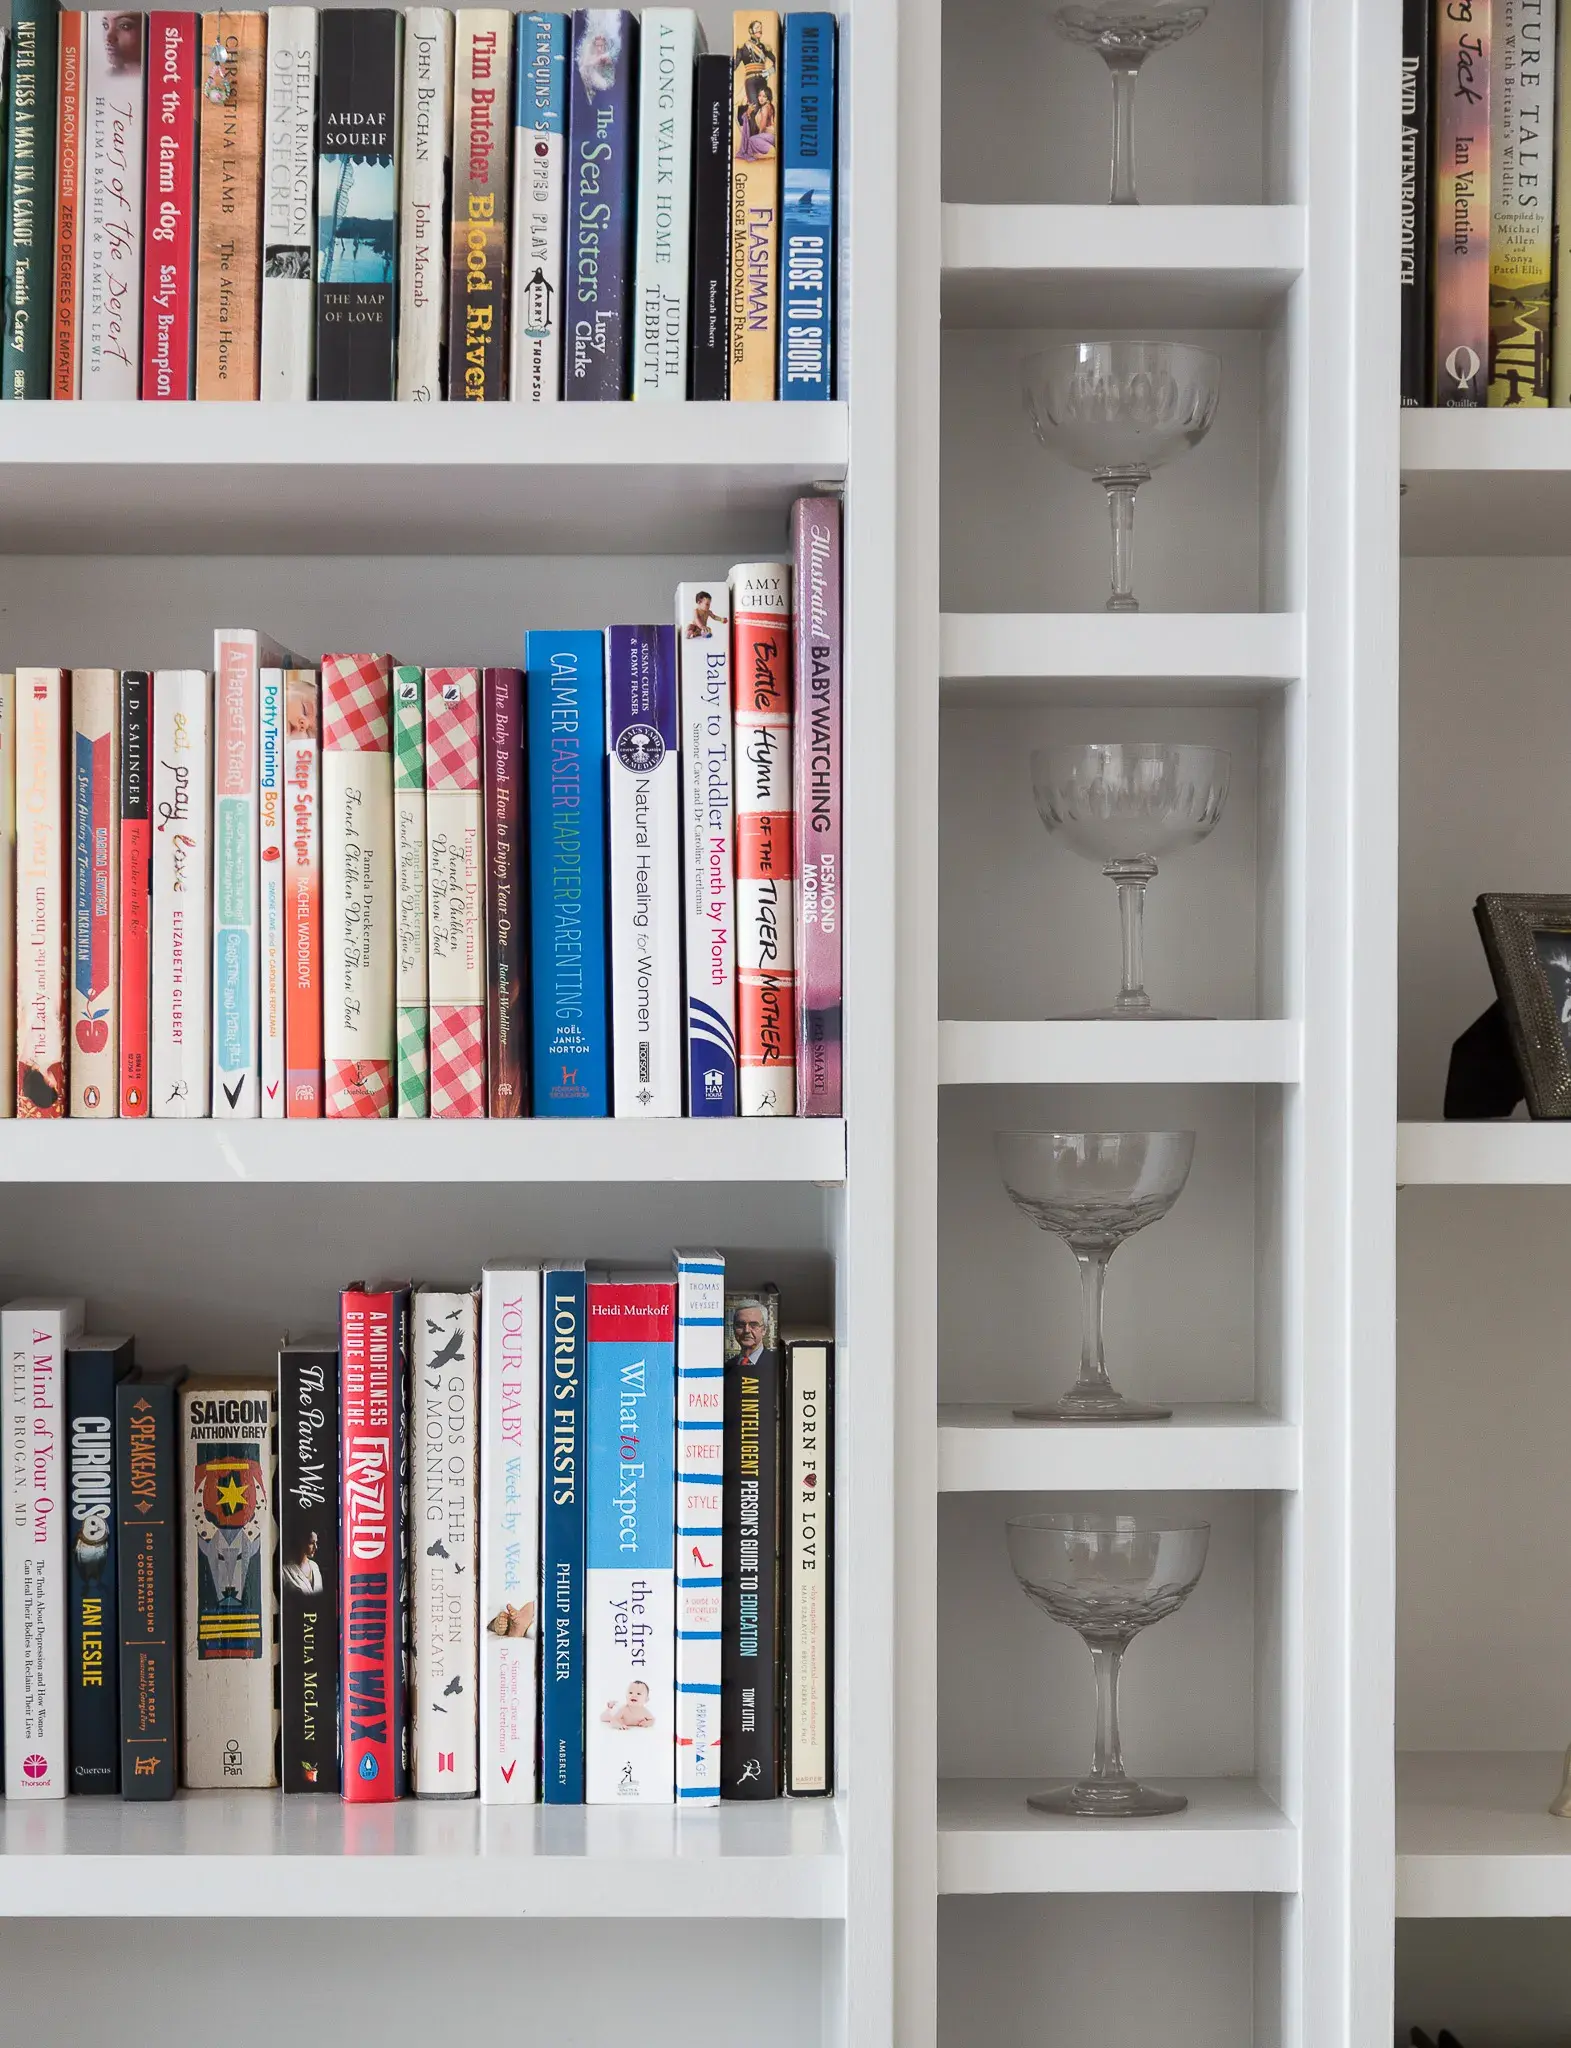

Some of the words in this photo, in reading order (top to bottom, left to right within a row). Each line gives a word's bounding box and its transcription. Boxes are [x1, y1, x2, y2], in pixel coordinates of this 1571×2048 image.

[16, 21, 36, 67] NEVER
[162, 27, 182, 83] shoot
[801, 27, 820, 88] MICHAEL
[1504, 34, 1515, 69] With
[16, 74, 35, 105] KISS
[64, 47, 76, 91] SIMON
[1454, 33, 1482, 105] Jack
[15, 112, 34, 121] A
[95, 96, 104, 160] HALIMA
[162, 91, 180, 123] the
[328, 112, 386, 125] AHDAF
[596, 105, 613, 139] The
[711, 101, 720, 125] Safari
[800, 96, 818, 157] CAPUZZO
[1503, 77, 1515, 139] Britain's
[15, 126, 34, 157] MAN
[63, 95, 75, 197] BARON-COHEN
[107, 101, 133, 171] Tears
[327, 133, 387, 145] SOUEIF
[710, 127, 719, 153] Nights
[1455, 136, 1474, 165] Ian
[1518, 105, 1539, 208] TALES
[14, 165, 33, 179] IN
[159, 135, 180, 192] damn
[580, 141, 611, 197] Sea
[1502, 146, 1513, 207] Wildlife
[14, 183, 33, 195] A
[94, 167, 104, 224] BASHIR
[105, 179, 131, 212] of
[735, 173, 747, 225] GEORGE
[13, 199, 32, 247] CANOE
[61, 205, 72, 240] ZERO
[153, 201, 180, 241] dog
[1454, 170, 1473, 255] Valentine
[93, 234, 102, 242] &
[104, 220, 135, 260] the
[467, 192, 494, 292] Blood
[578, 201, 609, 302] Sisters
[14, 258, 29, 305] Tanith
[60, 244, 72, 305] DEGREES
[92, 251, 102, 315] DAMIEN
[734, 230, 746, 313] MACDONALD
[748, 208, 772, 331] FLASHMAN
[789, 236, 824, 290] CLOSE
[155, 265, 176, 307] Sally
[708, 280, 717, 313] Deborah
[60, 308, 71, 328] OF
[104, 273, 133, 368] Desert
[788, 298, 823, 318] TO
[12, 309, 28, 353] Carey
[92, 323, 100, 373] LEWIS
[575, 321, 591, 377] Clarke
[592, 310, 612, 353] Lucy
[707, 316, 717, 348] Doherty
[733, 317, 745, 364] FRASER
[59, 331, 70, 392] EMPATHY
[153, 314, 174, 395] Brampton
[466, 305, 493, 401] River
[787, 327, 822, 382] SHORE
[742, 595, 784, 606] CHUA
[745, 579, 780, 589] AMY
[630, 648, 638, 677] ROMY
[641, 643, 649, 674] SUSAN
[128, 679, 139, 691] J.
[262, 686, 277, 727] Potty
[495, 684, 508, 709] The
[550, 653, 579, 733] CALMER
[631, 680, 639, 715] FRASER
[641, 677, 650, 711] CURTIS
[129, 700, 139, 715] D.
[493, 714, 509, 745] Baby
[811, 646, 830, 833] BABYWATCHING
[129, 723, 139, 805] SALINGER
[262, 728, 277, 787] Training
[496, 750, 509, 782] Book
[551, 738, 580, 808] EASIER
[262, 792, 277, 827] Boys
[497, 788, 509, 819] How
[636, 779, 650, 848] Natural
[96, 828, 106, 866] MARINA
[497, 823, 508, 835] to
[363, 850, 373, 890] Pamela
[494, 841, 510, 878] Enjoy
[553, 812, 581, 900] HAPPIER
[96, 871, 106, 916] LEWYCKA
[297, 877, 309, 920] RACHEL
[498, 883, 510, 914] Year
[634, 855, 650, 927] Healing
[804, 863, 818, 924] MORRIS
[821, 854, 835, 934] DESMOND
[173, 911, 183, 983] ELIZABETH
[363, 895, 373, 968] Druckerman
[499, 918, 511, 946] One
[638, 933, 648, 952] for
[298, 922, 310, 989] WADDILOVE
[554, 903, 583, 1018] PARENTING
[639, 956, 651, 1032] Women
[173, 990, 182, 1045] GILBERT
[557, 1025, 581, 1034] NOËL
[592, 1305, 621, 1316] Heidi
[624, 1305, 669, 1316] Murkoff
[32, 1328, 52, 1345] A
[554, 1295, 579, 1400] LORD'S
[33, 1355, 53, 1410] Mind
[742, 1377, 759, 1393] AN
[33, 1418, 53, 1438] of
[741, 1399, 759, 1476] INTELLIGENT
[33, 1443, 53, 1491] Your
[72, 1416, 111, 1521] CURIOUS
[554, 1409, 575, 1505] FIRSTS
[33, 1497, 54, 1543] Own
[741, 1481, 759, 1536] PERSON'S
[24, 1559, 32, 1575] Can
[36, 1560, 44, 1575] The
[740, 1539, 758, 1572] GUIDE
[24, 1577, 33, 1596] Heal
[36, 1577, 45, 1599] Truth
[557, 1563, 570, 1612] PHILIP
[632, 1581, 652, 1621] the
[740, 1575, 758, 1590] TO
[24, 1598, 33, 1619] Their
[36, 1601, 45, 1625] About
[83, 1598, 101, 1625] IAN
[347, 1572, 387, 1661] RUBY
[610, 1600, 630, 1647] year
[740, 1593, 758, 1656] EDUCATION
[24, 1622, 33, 1648] Bodies
[25, 1650, 32, 1658] to
[35, 1627, 45, 1670] Depression
[303, 1612, 317, 1664] PAULA
[557, 1619, 569, 1681] BARKER
[632, 1623, 652, 1666] first
[25, 1660, 33, 1693] Reclaim
[37, 1672, 45, 1686] and
[83, 1632, 102, 1686] LESLIE
[25, 1695, 33, 1716] Their
[37, 1689, 45, 1707] How
[303, 1672, 317, 1741] McLAIN
[349, 1669, 387, 1744] WAX
[742, 1688, 754, 1706] TONY
[25, 1718, 33, 1739] Lives
[37, 1709, 45, 1738] Women
[742, 1709, 754, 1732] LITTLE
